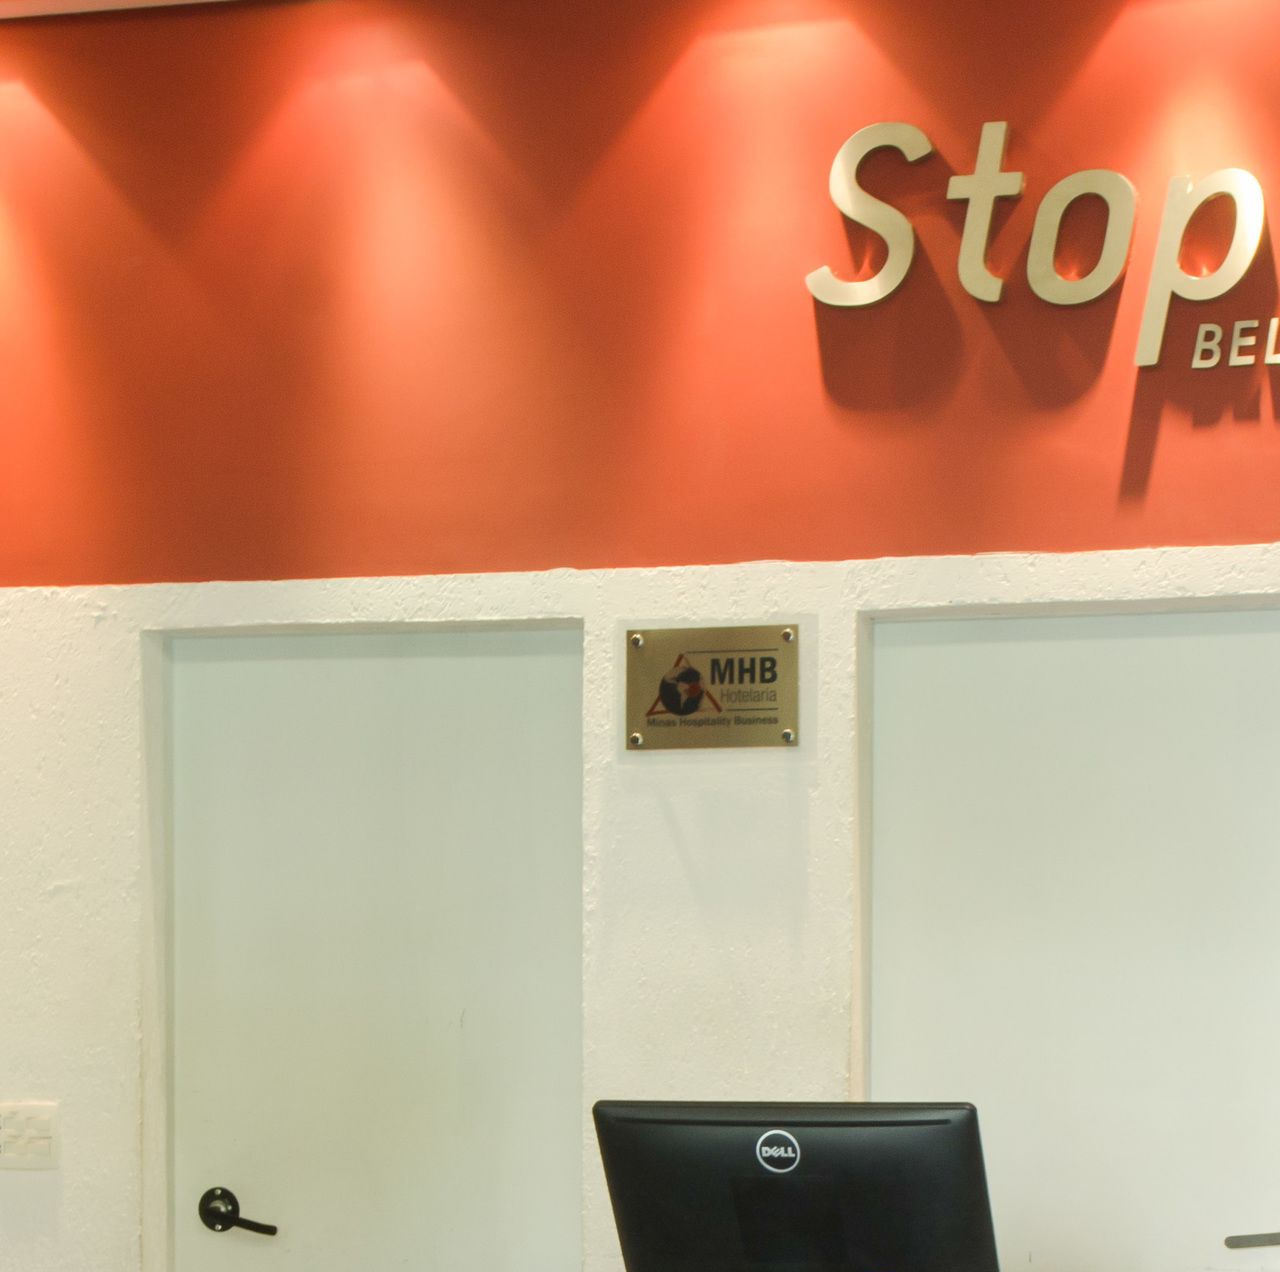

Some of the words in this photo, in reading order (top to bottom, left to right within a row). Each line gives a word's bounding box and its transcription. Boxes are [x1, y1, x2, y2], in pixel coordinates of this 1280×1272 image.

[805, 120, 1265, 366] Stop
[710, 656, 778, 685] MHB
[721, 688, 777, 704] Hotelaria
[647, 717, 677, 728] Minas
[679, 716, 732, 728] Hospitality
[734, 715, 779, 726] Business
[761, 1146, 796, 1157] DELL
